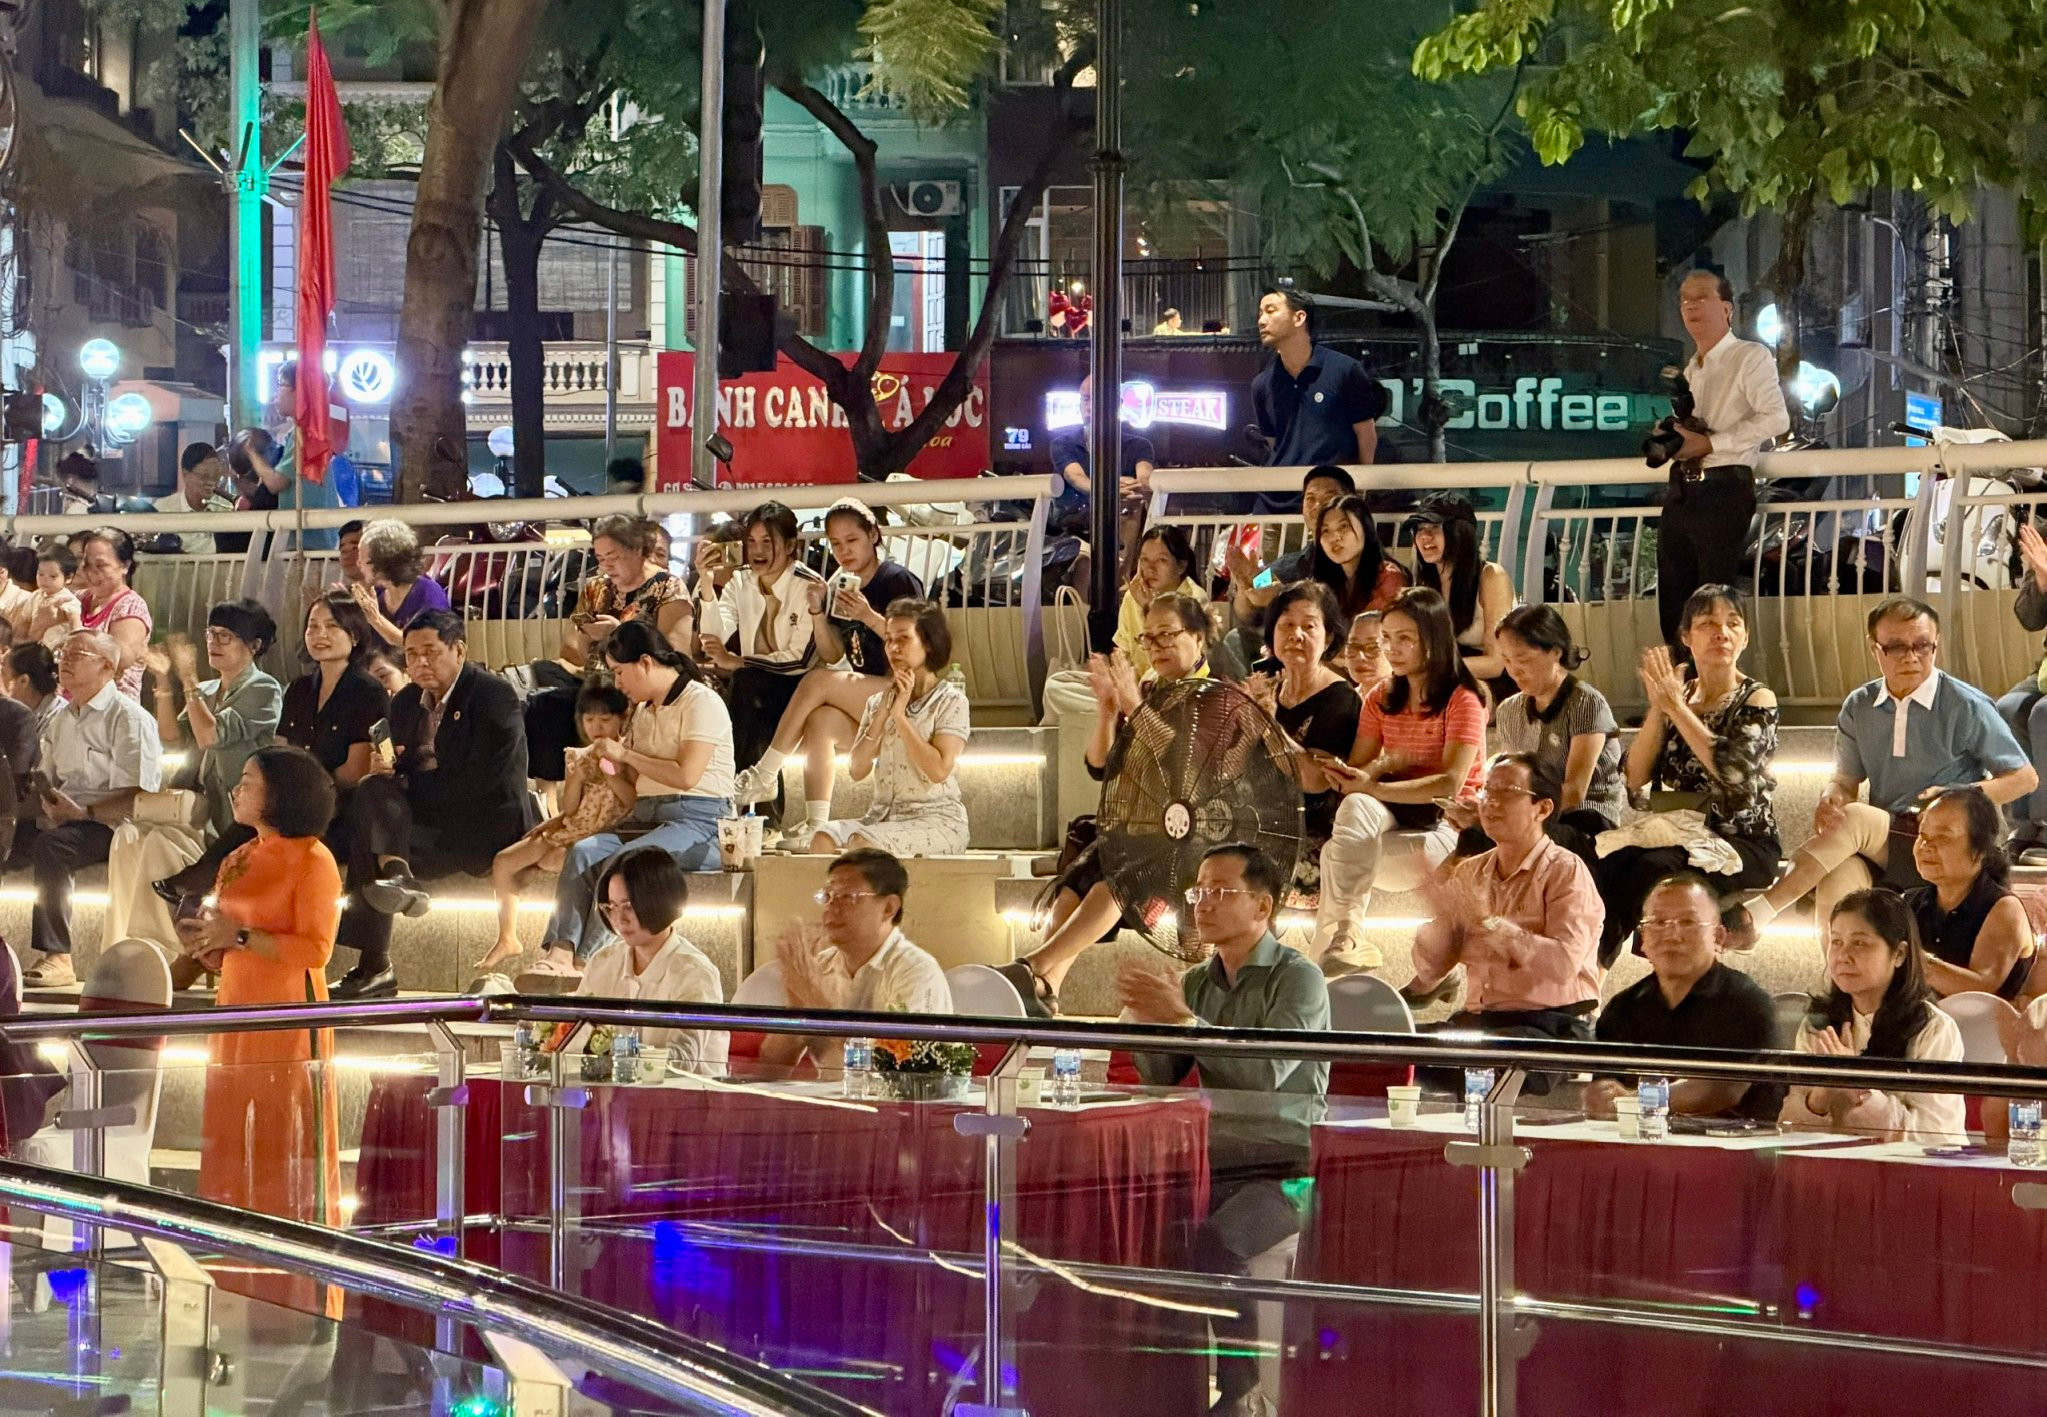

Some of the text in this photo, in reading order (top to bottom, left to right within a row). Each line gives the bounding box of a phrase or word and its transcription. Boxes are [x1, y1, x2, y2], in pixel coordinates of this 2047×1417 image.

[667, 386, 756, 428] BNH
[1158, 398, 1219, 422] STEAK
[1005, 428, 1029, 443] 79
